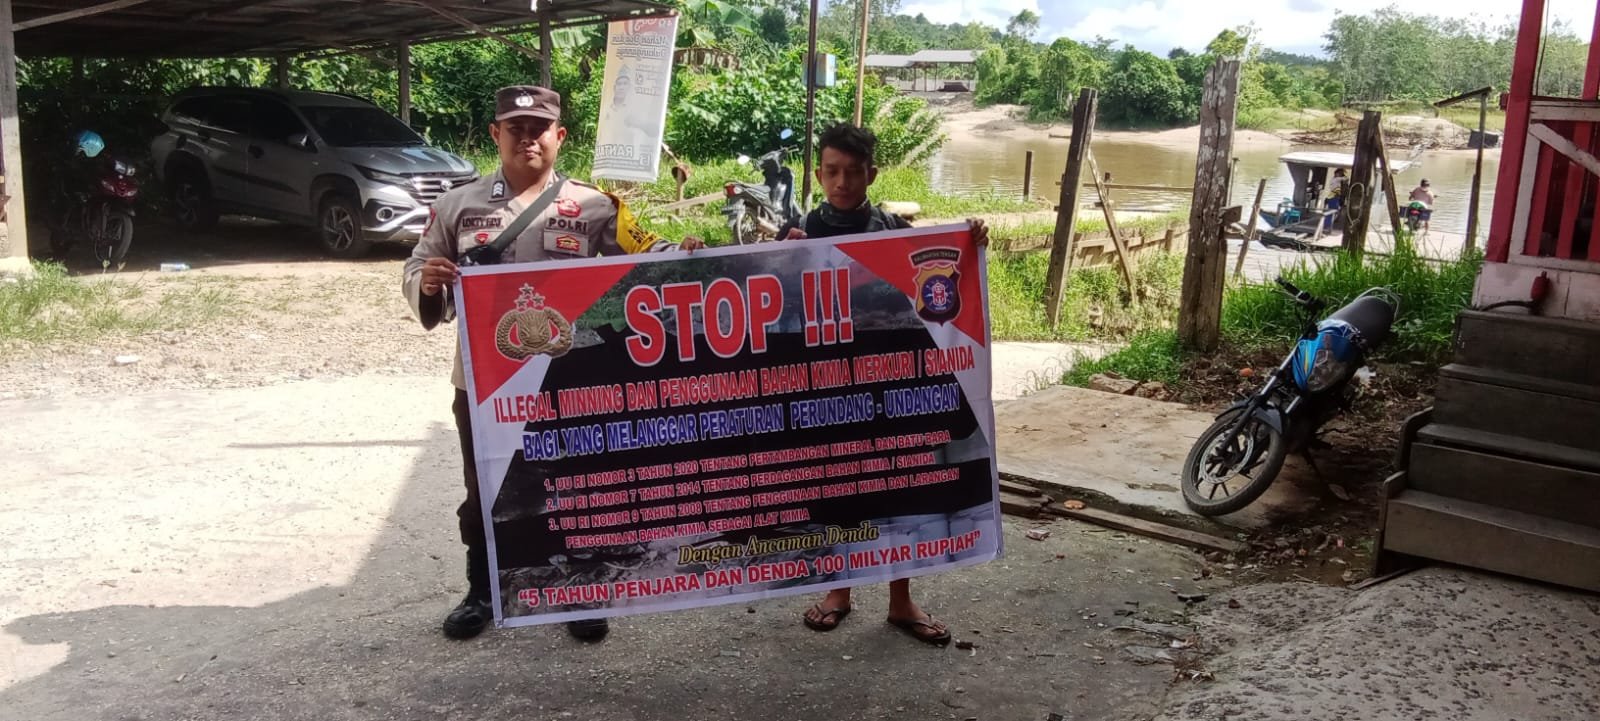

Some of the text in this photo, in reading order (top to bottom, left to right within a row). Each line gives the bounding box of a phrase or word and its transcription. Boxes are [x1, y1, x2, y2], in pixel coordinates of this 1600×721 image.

[549, 218, 587, 231] POLRI
[625, 267, 854, 366] STOP !!!
[494, 392, 556, 423] ILLEGAL
[558, 384, 624, 418] MINNING
[626, 380, 656, 411] DAN
[660, 370, 758, 408] PENGGUNAAN
[761, 363, 808, 394] BAHAN
[811, 358, 850, 389] KIMIA
[854, 349, 916, 385] MERKURI
[924, 346, 975, 377] SIANIDA
[523, 430, 560, 461] BAGI
[563, 423, 604, 457] YANG
[606, 414, 698, 452] MELANGGAR
[700, 403, 784, 440] PERATURAN
[790, 392, 874, 430] PERUNDANG
[884, 383, 960, 419] UNDANGAN
[544, 430, 951, 492] 1. UU RI NOMOR 3 TAHUN 2020 TENTANG PERTAMBANGAN MINERAL DAN BATU BARA
[546, 498, 558, 512] 2.
[558, 496, 574, 511] UU
[576, 495, 588, 509] RI
[589, 490, 628, 508] NOMOR
[630, 489, 636, 502] 7
[639, 484, 675, 501] TAHUN
[676, 480, 700, 496] 2014
[702, 474, 749, 492] TENTANG
[751, 464, 824, 487] PERDAGANGAN
[826, 460, 860, 478] BAHAN
[862, 456, 890, 472] KIMIA
[896, 451, 936, 468] SIANIDA
[548, 468, 960, 530] 3. UU RI NOMOR 9 TAHUN 2008 TENTANG PENGGUNAAN BAHAN KIMIA DAN LARANGAN
[566, 508, 810, 549] PENGGUNAAN BAHAN KIMIA SEBAGAI ALAT KIMIA
[677, 520, 880, 566] Dengan Ancaman Denda
[544, 583, 610, 606] TAHUN
[614, 572, 700, 600] PENJARA
[705, 567, 744, 591] DAN
[746, 560, 809, 584] DENDA
[814, 554, 845, 576] 100
[850, 544, 914, 570] MILYAR
